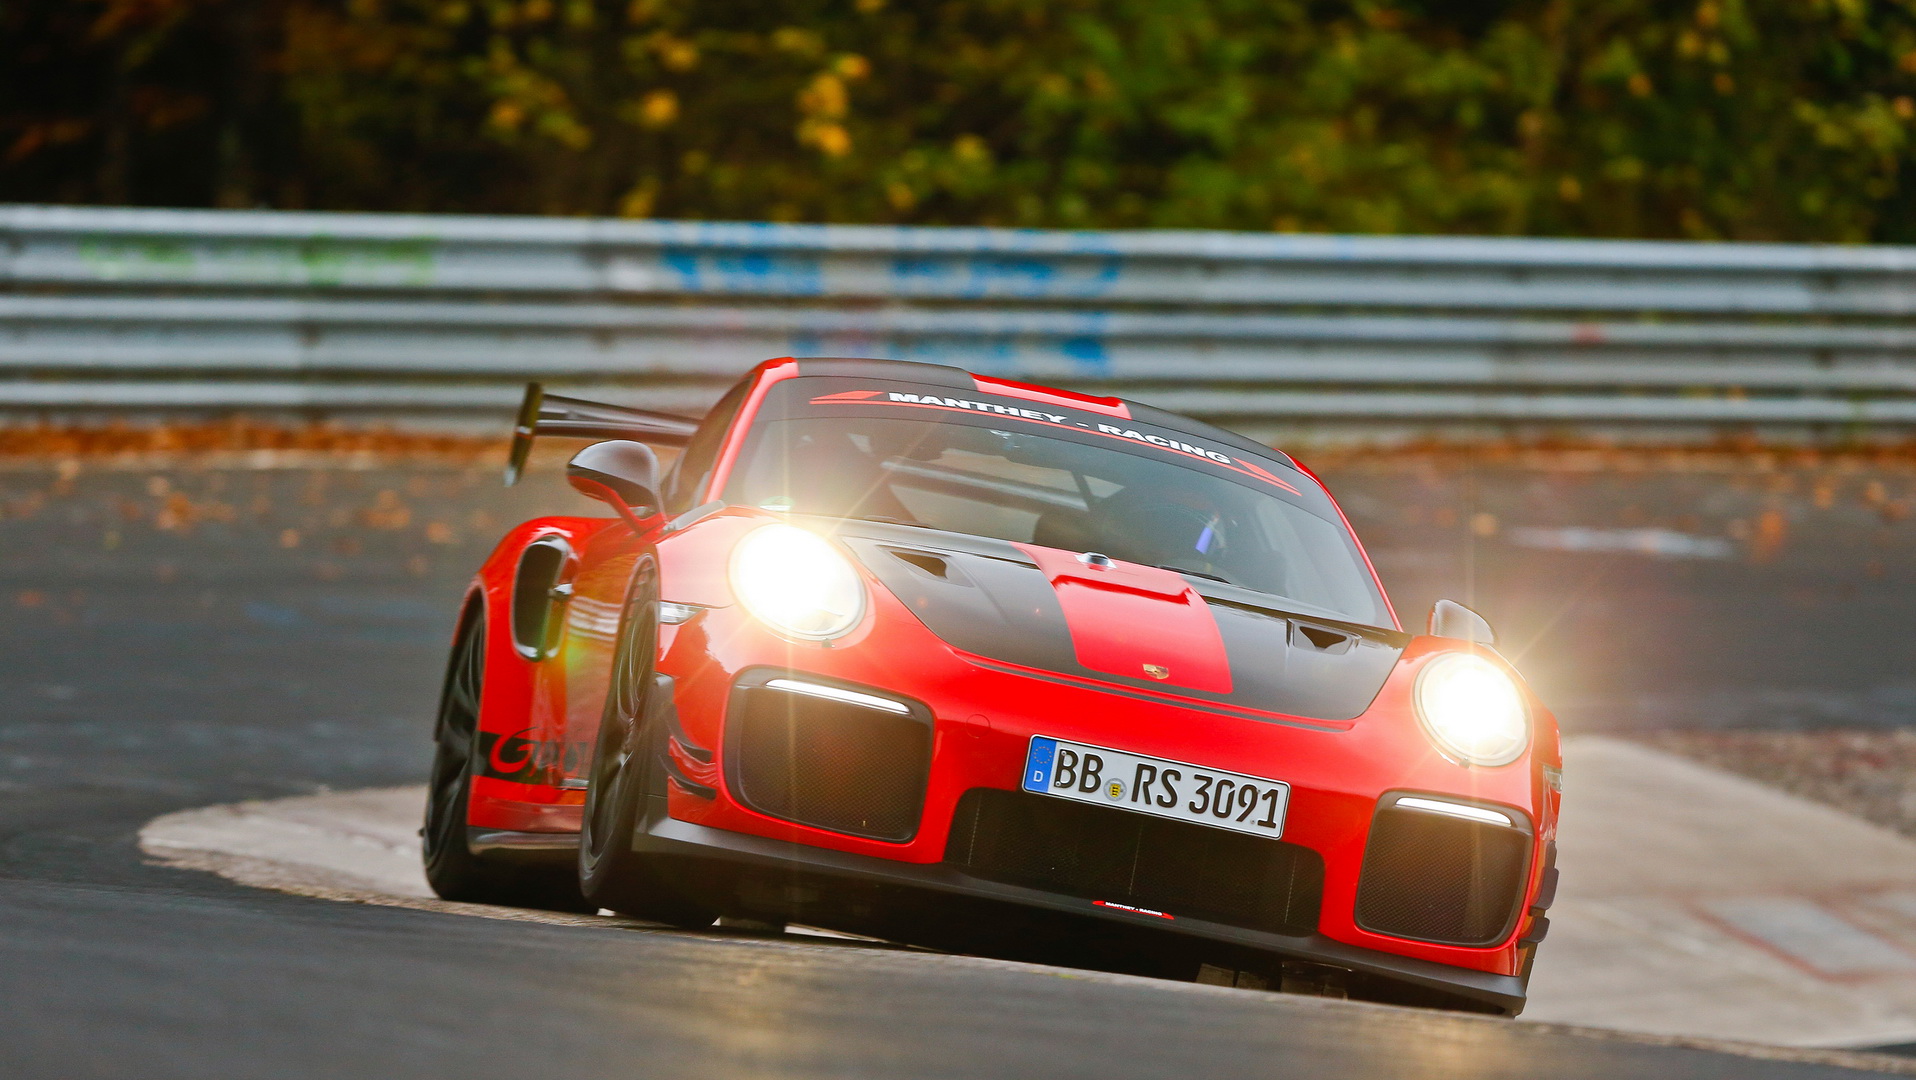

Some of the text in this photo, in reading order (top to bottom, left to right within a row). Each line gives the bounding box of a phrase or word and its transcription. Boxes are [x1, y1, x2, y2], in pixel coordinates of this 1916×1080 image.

[888, 393, 1067, 424] MANTHEY
[1098, 424, 1231, 465] RACING
[1033, 770, 1044, 782] D
[1054, 749, 1278, 828] BB RS 3091
